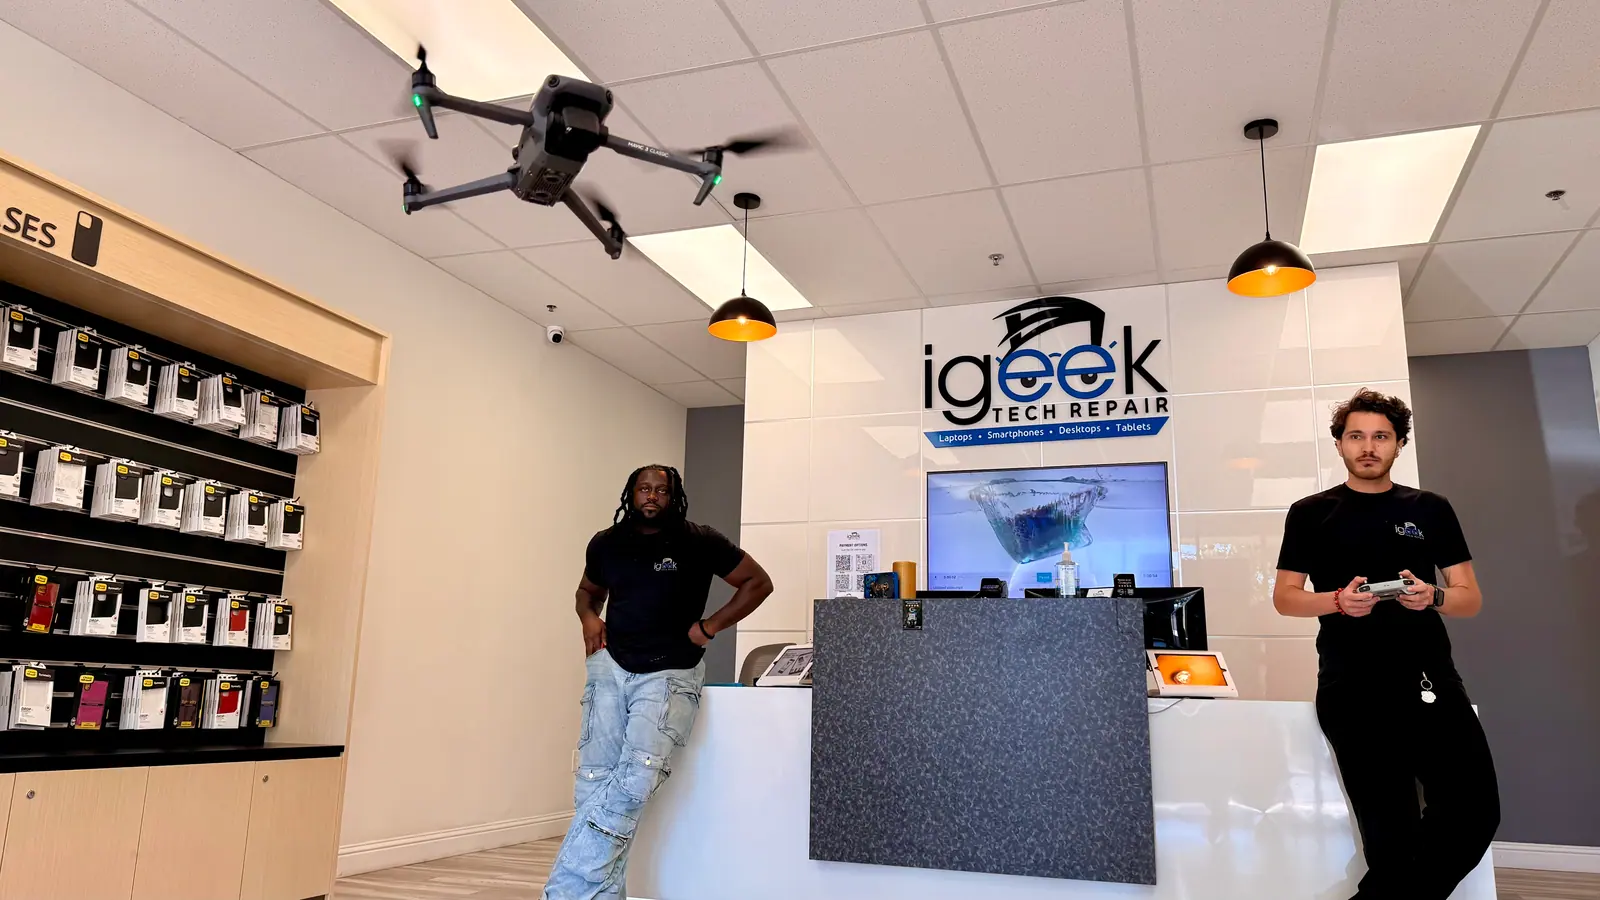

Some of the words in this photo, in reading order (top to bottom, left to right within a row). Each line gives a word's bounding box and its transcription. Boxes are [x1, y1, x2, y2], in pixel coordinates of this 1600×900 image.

[0, 206, 57, 248] SES
[924, 325, 1168, 426] igeek
[992, 403, 1056, 423] TECH
[1070, 396, 1168, 418] REPAIR
[938, 432, 973, 444] Laptops
[987, 428, 1045, 440] Smartphones
[1058, 424, 1101, 436] Desktops
[1115, 422, 1152, 433] Tablets
